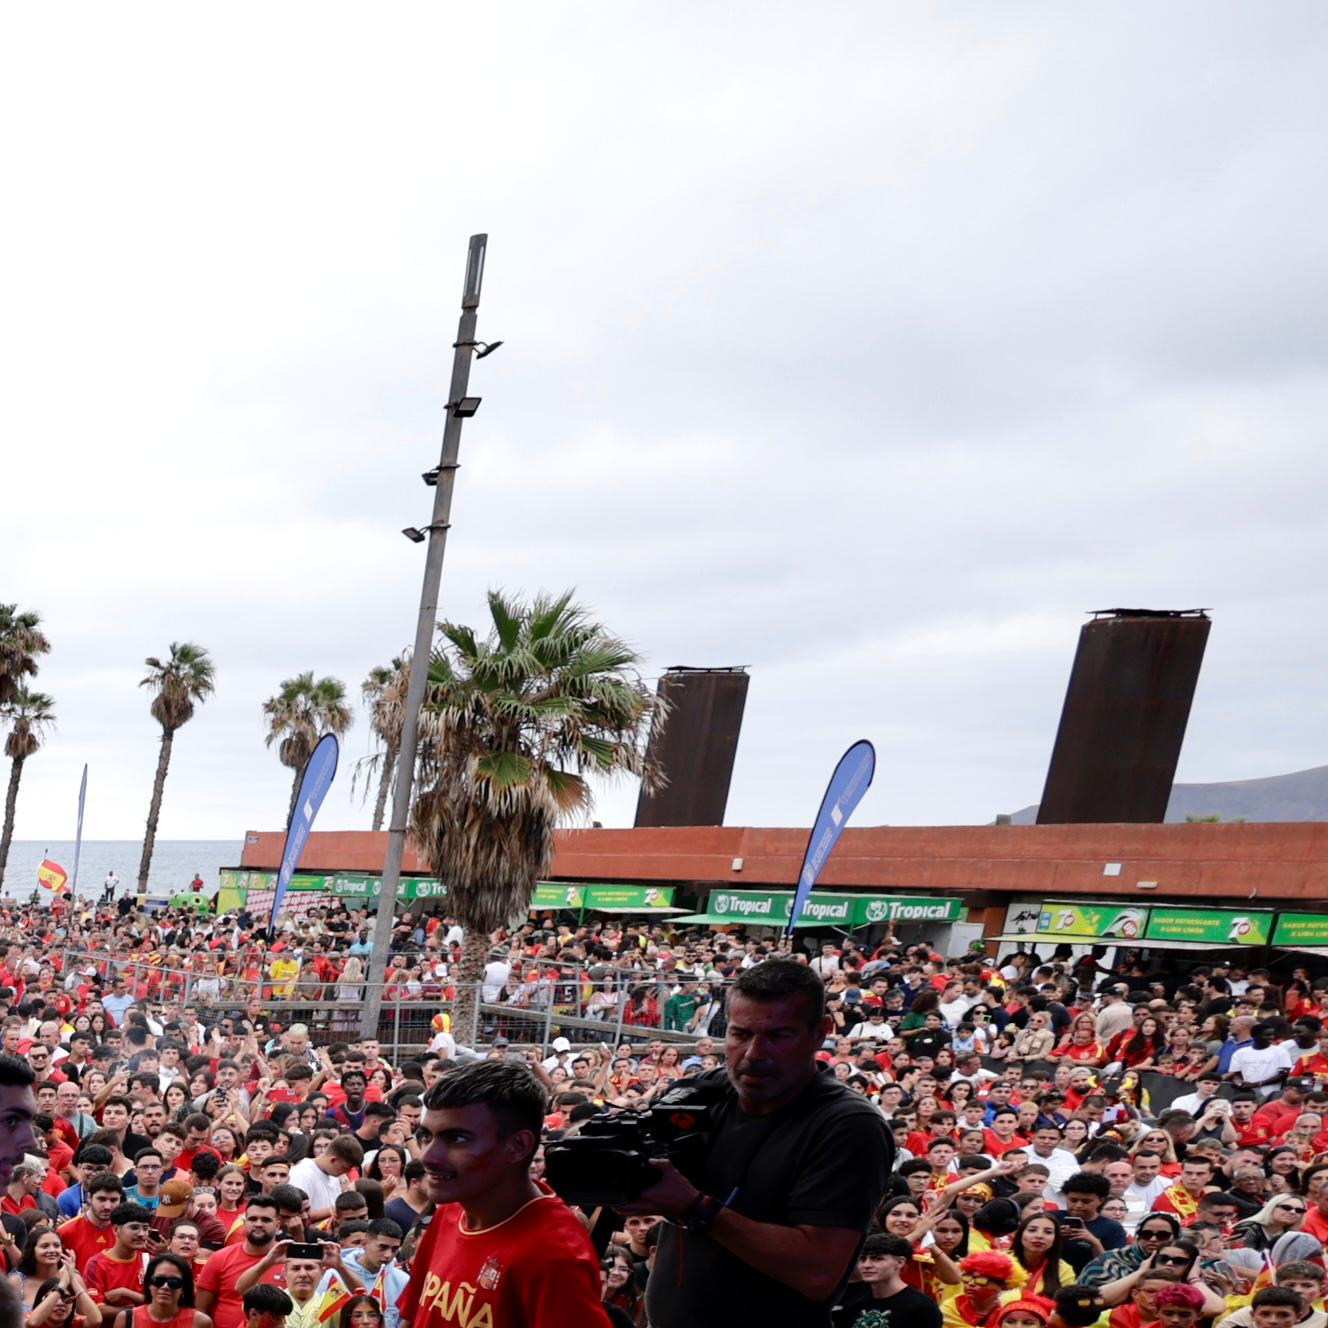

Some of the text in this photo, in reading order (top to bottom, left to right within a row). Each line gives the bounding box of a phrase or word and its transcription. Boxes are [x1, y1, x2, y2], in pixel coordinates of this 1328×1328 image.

[730, 895, 772, 914] Tropical
[802, 899, 849, 919] Tropical
[889, 902, 952, 921] Tropical
